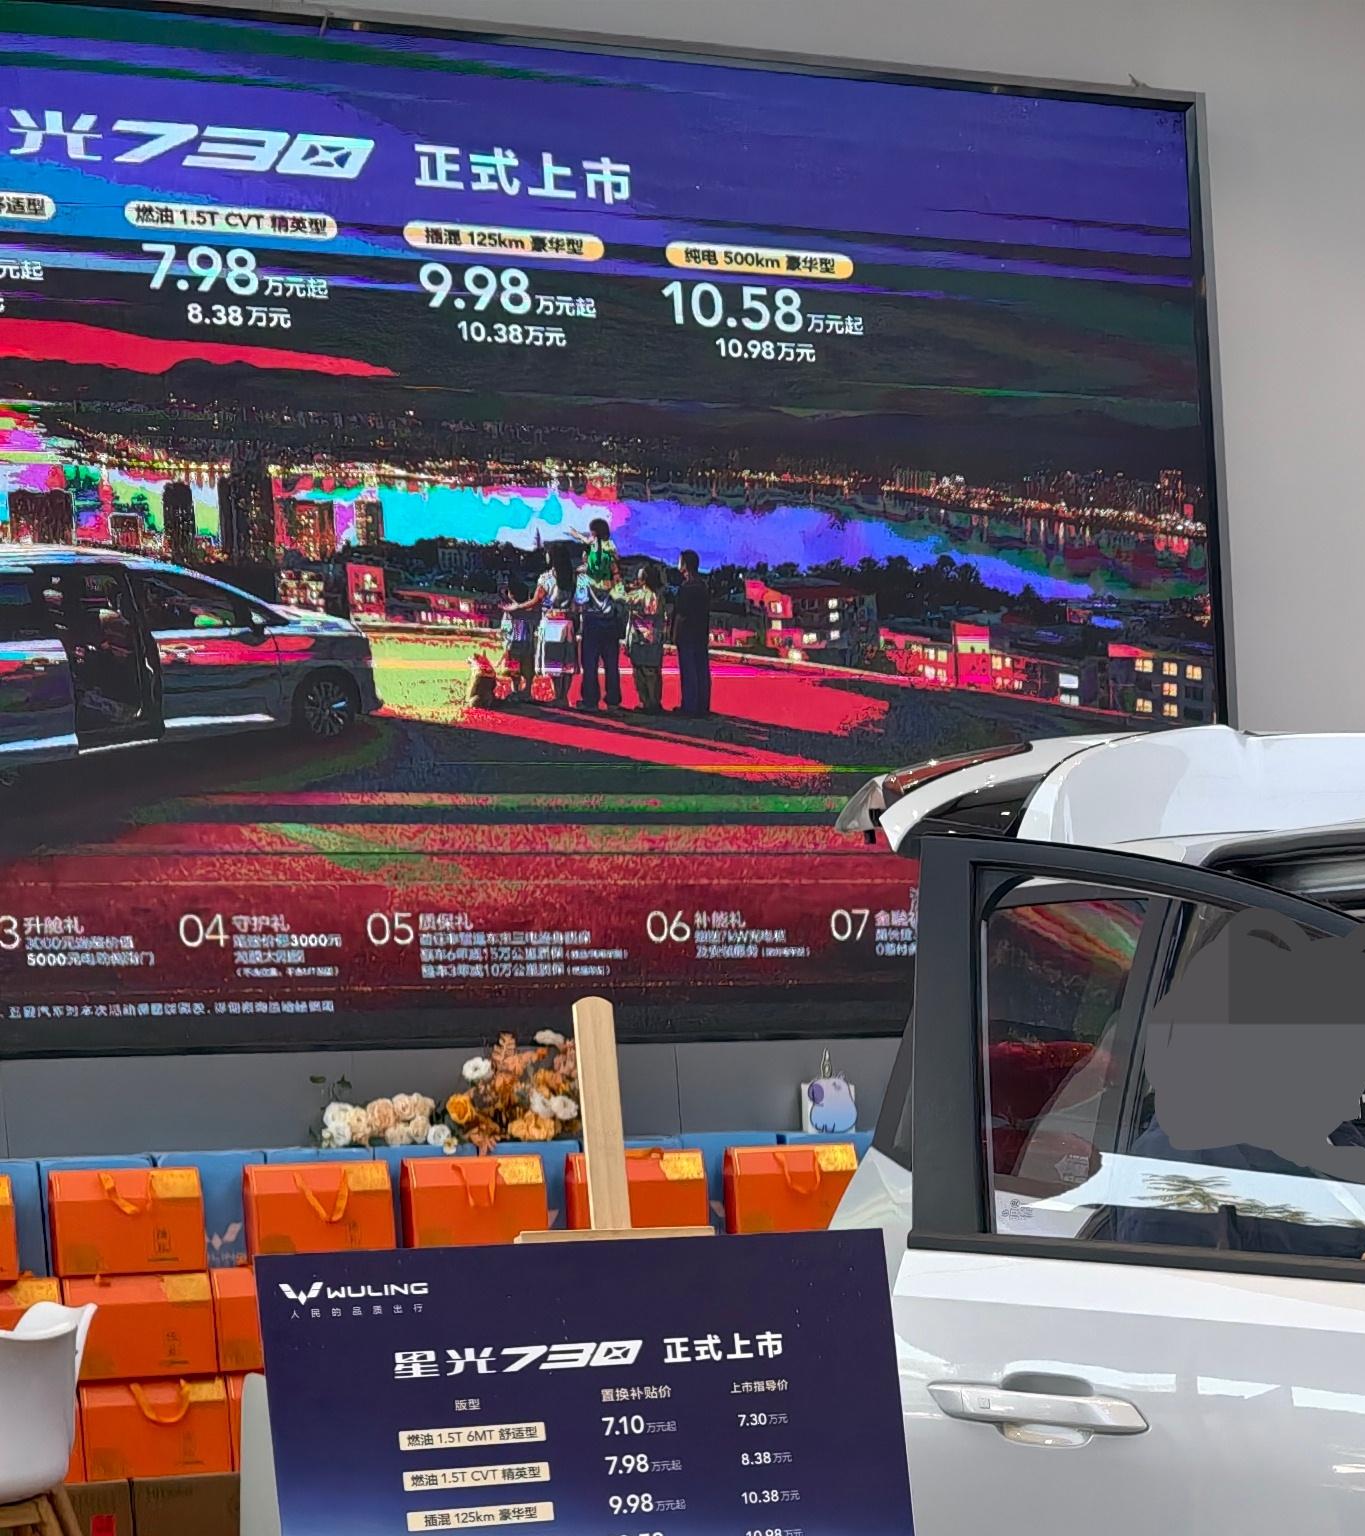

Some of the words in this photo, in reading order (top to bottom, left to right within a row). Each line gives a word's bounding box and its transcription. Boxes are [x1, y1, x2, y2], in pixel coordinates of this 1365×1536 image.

[413, 142, 632, 205] 正式上市
[135, 203, 175, 225] 燃油
[180, 208, 219, 226] 1.5T
[225, 213, 265, 230] CVT
[271, 214, 328, 235] 精英型
[467, 231, 525, 252] 125km
[530, 232, 584, 256] 豪华型
[684, 248, 718, 265] 纯电
[724, 251, 781, 270] 500km
[785, 254, 836, 275] 豪华型
[187, 302, 292, 329] 8.38万元
[456, 320, 567, 348] 10.38万元
[715, 337, 816, 363] 10.98万元
[179, 913, 230, 948] 04
[366, 912, 415, 945] 05
[646, 910, 691, 943] 06
[830, 908, 870, 941] 07
[326, 1282, 429, 1299] WULING
[662, 1331, 784, 1364] 正式上市
[601, 1385, 672, 1402] 置换补贴价
[730, 1379, 789, 1394] 上市指导价
[454, 1398, 481, 1411] 版型
[407, 1433, 434, 1447] 燃油
[436, 1431, 463, 1444] 1.5T
[466, 1429, 495, 1442] 6MT
[498, 1425, 538, 1441] 舒适型
[411, 1474, 438, 1487] 燃油
[441, 1472, 468, 1484] 1.5T
[471, 1469, 498, 1482] CVT
[501, 1465, 542, 1481] 精英型
[424, 1513, 452, 1527] 插混
[454, 1510, 495, 1524] 125km
[499, 1506, 538, 1521] 豪华型
